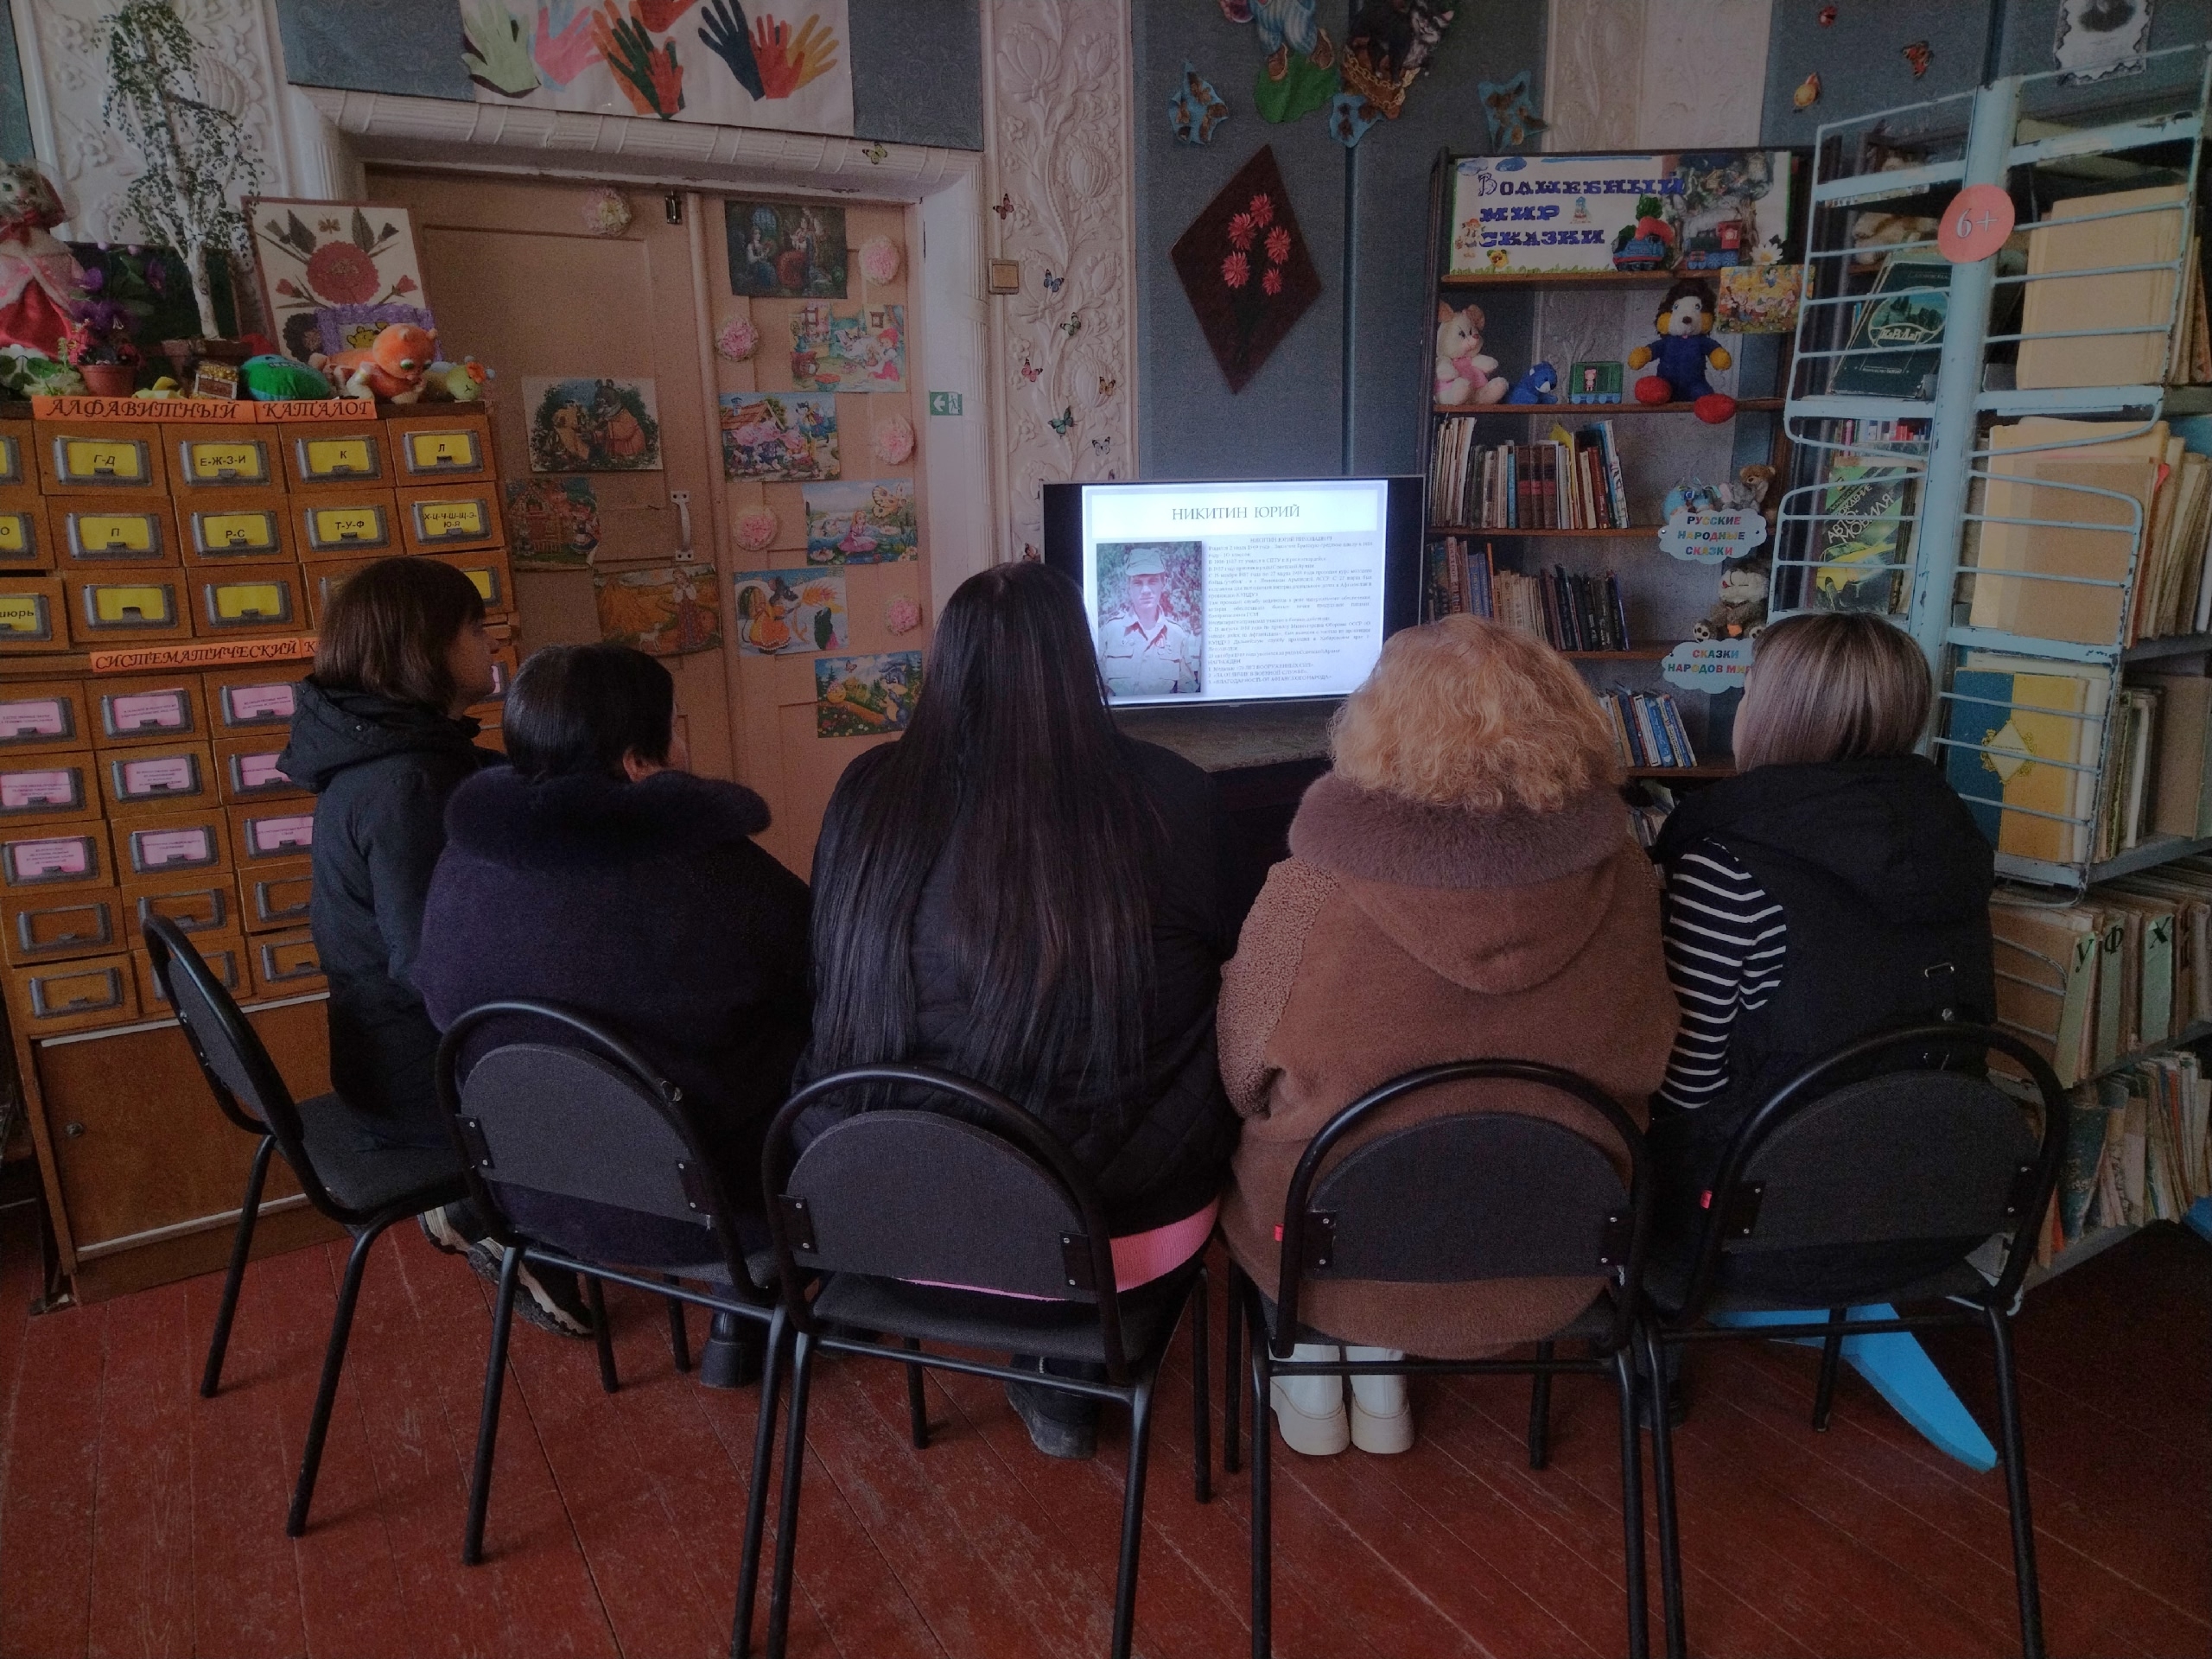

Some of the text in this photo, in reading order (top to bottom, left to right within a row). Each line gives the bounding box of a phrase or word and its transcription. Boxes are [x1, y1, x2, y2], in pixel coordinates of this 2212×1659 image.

[1479, 205, 1560, 222] МИР
[1955, 208, 1998, 238] 6+
[1479, 230, 1605, 247] СКАЗКИ
[47, 397, 371, 418] АЛФАВИТНЫЙ КАТАЛОГ
[200, 454, 246, 466] Е-Ж-З-И
[340, 450, 347, 459] К
[93, 455, 116, 467] Г-Д
[1172, 505, 1300, 520] НИКИТИН ЮРИЙ
[335, 520, 365, 531] Т-У-Ф
[1687, 516, 1742, 525] РУССКИЕ
[111, 528, 120, 537] П
[226, 530, 245, 539] Р-С
[1677, 530, 1745, 542] НАРОДНЫЕ
[1685, 546, 1733, 556] СКАЗКИ
[95, 640, 297, 671] СИСТЕМАТИЧЕСКИЙ
[1692, 650, 1739, 659] СКАЗКИ
[1668, 664, 1723, 674] НАРОДОВ
[2104, 925, 2124, 954] Ф
